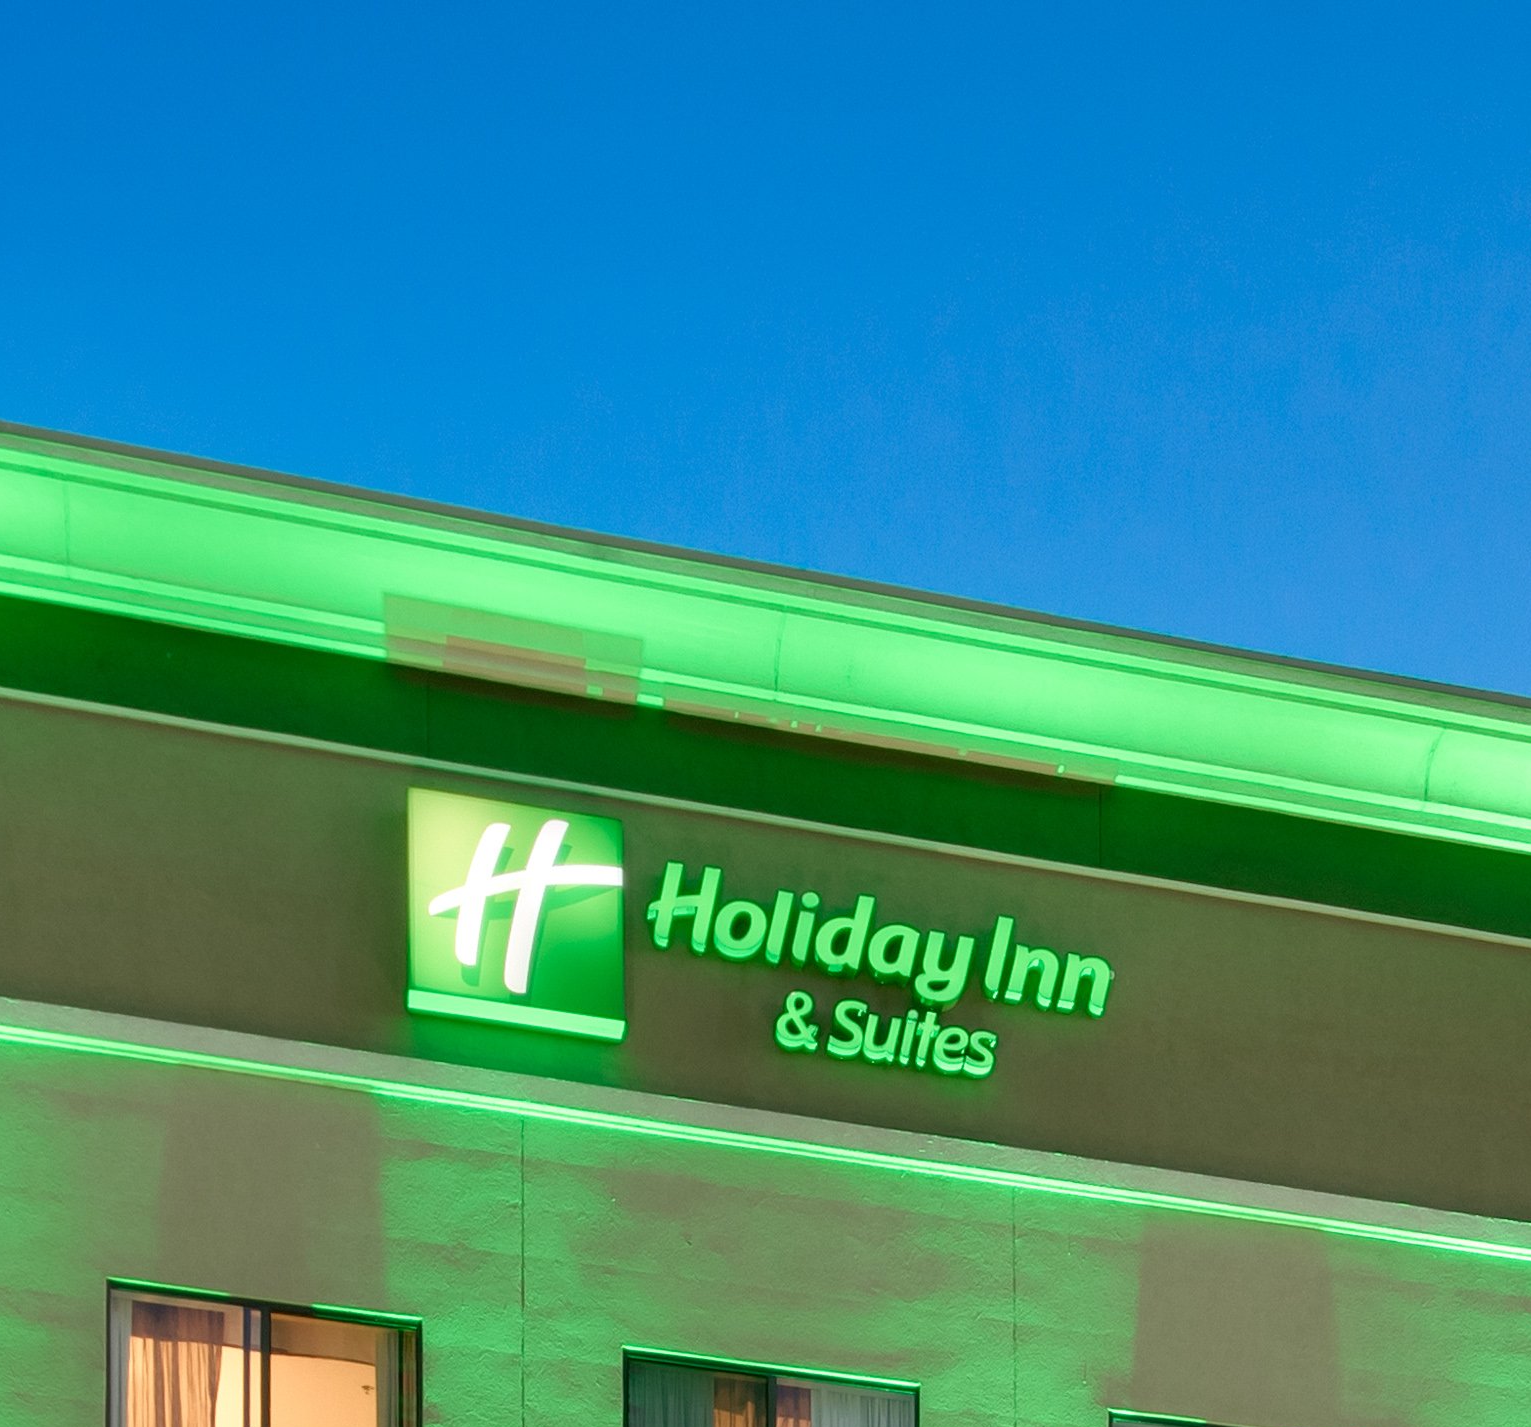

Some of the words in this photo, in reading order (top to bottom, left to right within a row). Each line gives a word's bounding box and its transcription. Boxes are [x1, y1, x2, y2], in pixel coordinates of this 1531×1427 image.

[428, 819, 624, 994] H
[647, 861, 975, 1004] Holiday
[984, 915, 1112, 1017] Inn
[775, 990, 819, 1051] &
[826, 999, 999, 1076] Suites
